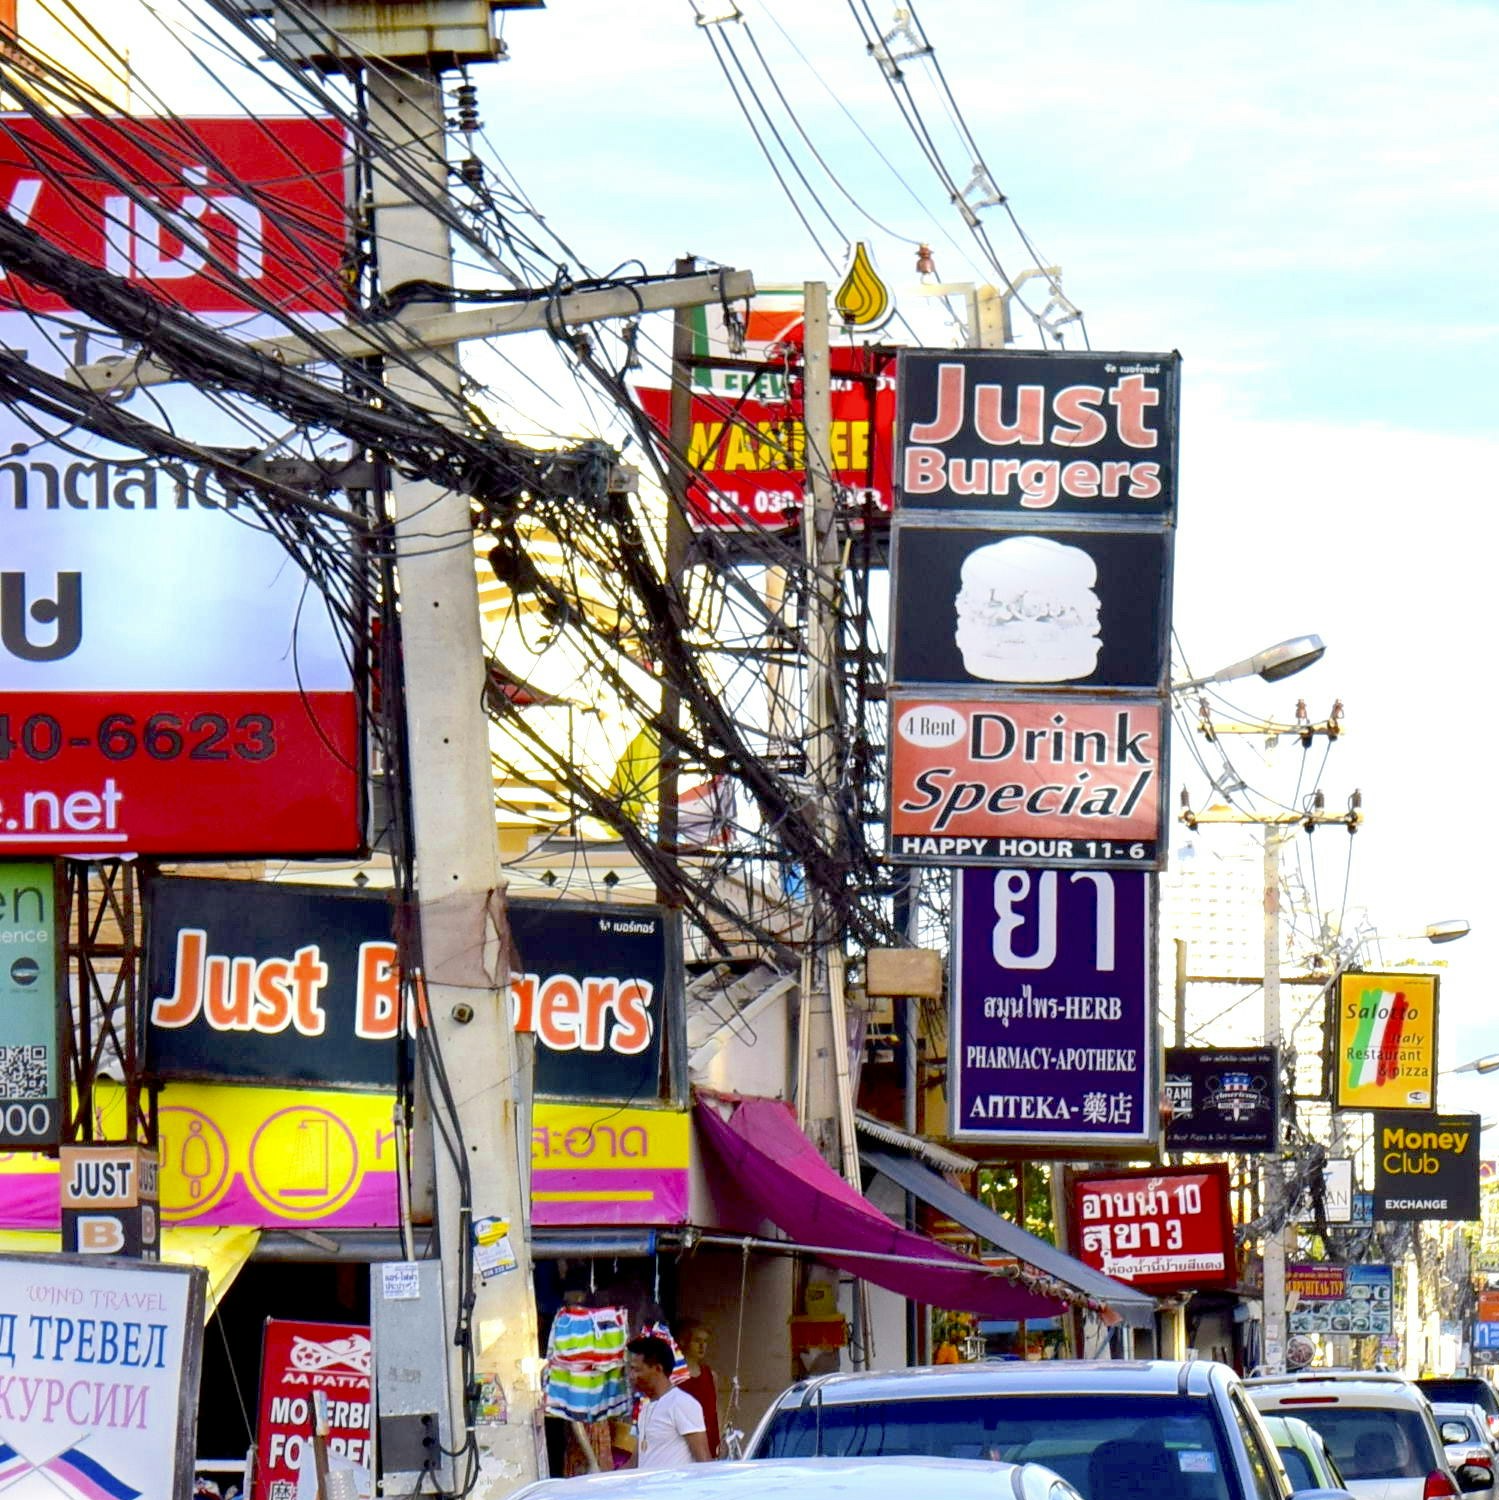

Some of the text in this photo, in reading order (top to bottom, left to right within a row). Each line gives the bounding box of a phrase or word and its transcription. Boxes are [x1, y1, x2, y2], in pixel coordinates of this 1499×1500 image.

[909, 363, 1160, 448] Just
[904, 446, 1162, 509] Burgers
[920, 718, 956, 737] Rent
[968, 712, 1153, 765] Drink
[0, 778, 122, 830] .net
[900, 768, 1154, 831] Special
[902, 838, 988, 857] HAPPY
[999, 839, 1074, 858] HOUR
[992, 870, 1116, 971] ยา
[151, 928, 329, 1037] Just
[1346, 1003, 1418, 1020] Salotto
[966, 1046, 1136, 1072] PHARMACY-APOTHEKE
[1346, 1047, 1421, 1062] Restaurant
[1393, 1064, 1429, 1079] pizza
[0, 1104, 50, 1136] 00
[1383, 1128, 1469, 1153] Money
[1383, 1152, 1440, 1174] Club
[69, 1160, 133, 1198] JUST
[1173, 1184, 1201, 1215] 10
[1385, 1199, 1448, 1210] EXCHANGE
[77, 1216, 125, 1254] B
[1166, 1219, 1182, 1249] 3
[27, 1286, 168, 1311] WIND TRAVEL
[29, 1314, 168, 1368] ТРЕВЕЛ
[281, 1372, 309, 1386] AA
